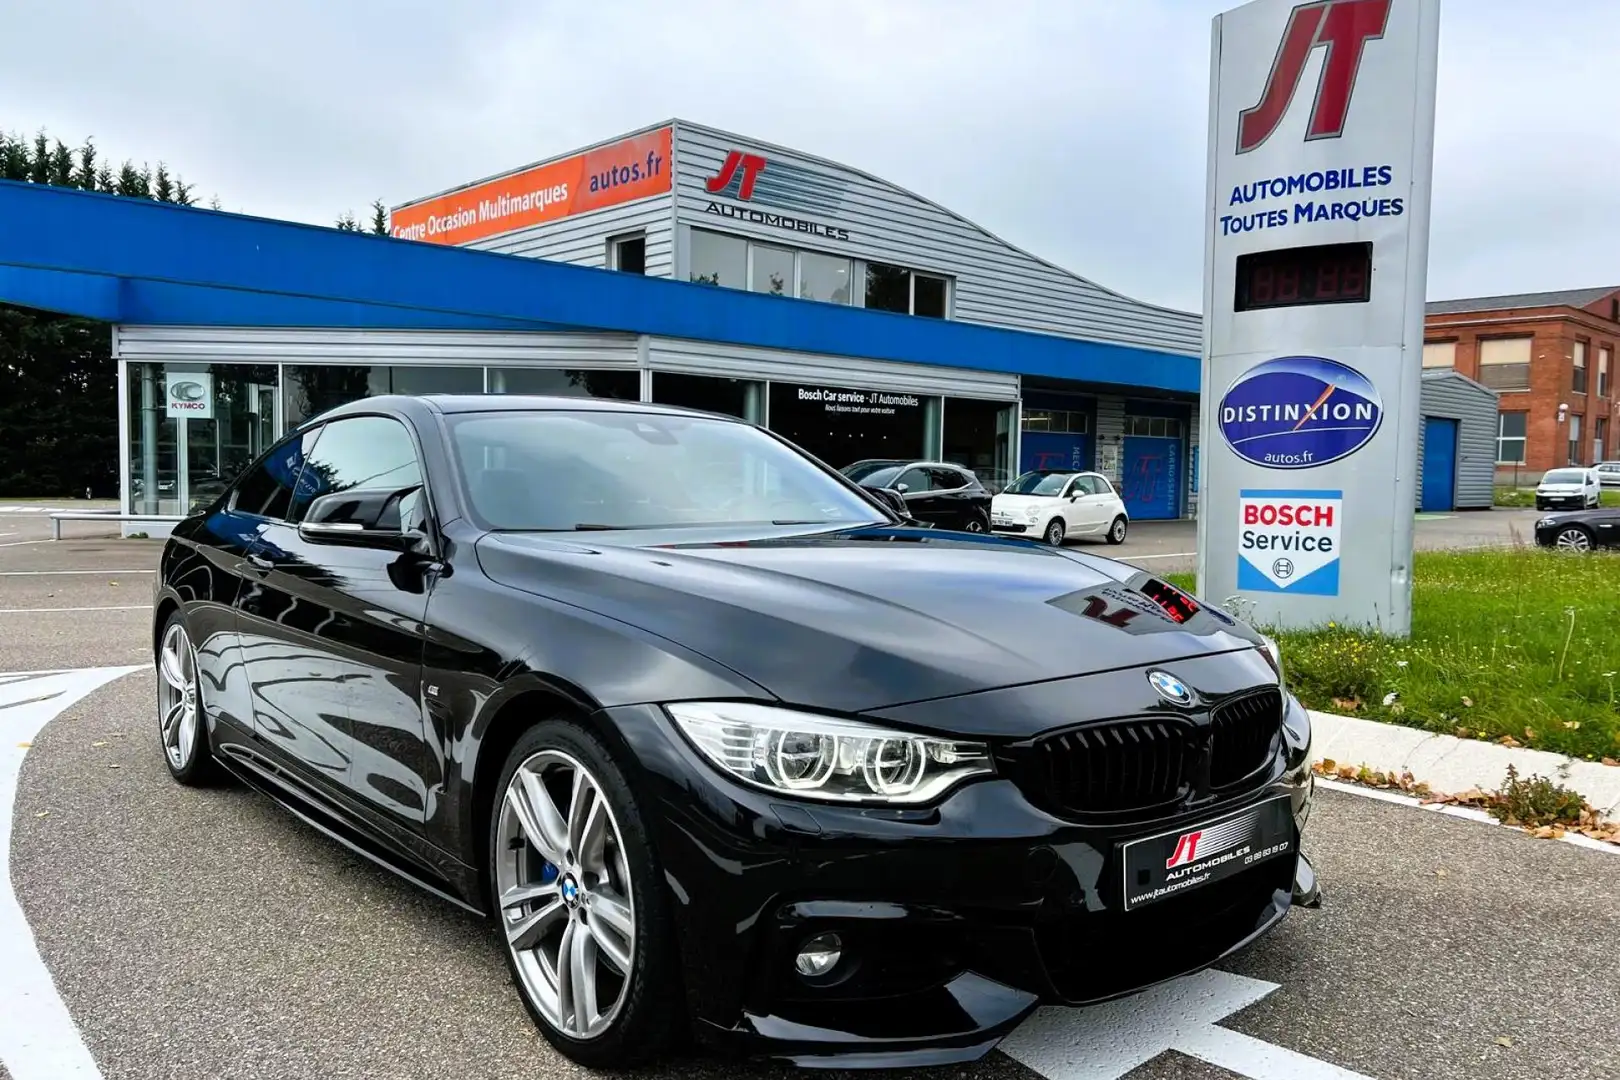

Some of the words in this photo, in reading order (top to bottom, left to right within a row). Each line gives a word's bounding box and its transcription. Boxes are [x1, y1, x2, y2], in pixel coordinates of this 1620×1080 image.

[1235, 0, 1393, 155] JT
[589, 150, 662, 192] autos.fr
[705, 149, 767, 201] JT
[1229, 165, 1392, 206] AUTOMOBILES
[427, 208, 476, 236] Occasion
[478, 183, 568, 224] Multimarques
[705, 202, 850, 241] AUTOMOBILES
[171, 402, 205, 410] KYMCO
[798, 387, 822, 400] Bosch
[823, 389, 837, 401] Car
[837, 391, 865, 403] service
[869, 392, 878, 404] JT
[878, 393, 919, 406] Automobiles
[1223, 402, 1373, 423] DISTINXION
[1264, 450, 1314, 464] autos.fr
[1243, 504, 1334, 527] BOSCH
[1242, 530, 1333, 552] Service
[1165, 845, 1251, 881] AUTOMOBILES
[1166, 830, 1202, 869] JT
[1279, 841, 1288, 851] 07
